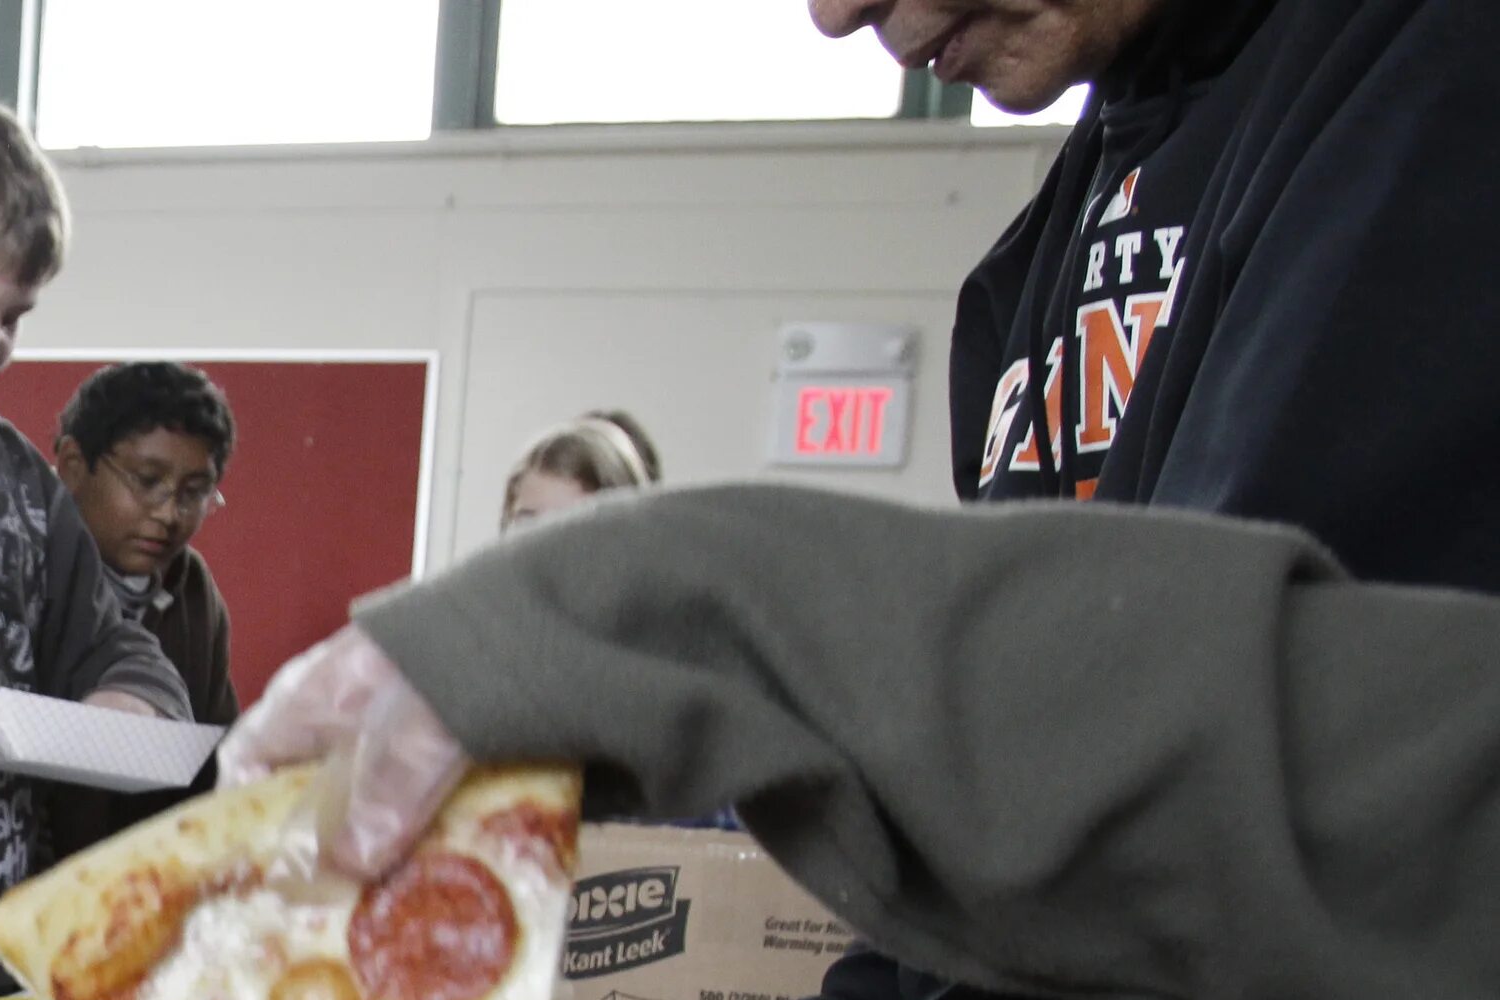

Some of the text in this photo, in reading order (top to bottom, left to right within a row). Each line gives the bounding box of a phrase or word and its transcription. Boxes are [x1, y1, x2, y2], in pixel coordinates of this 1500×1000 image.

[795, 386, 894, 456] EXIT
[765, 916, 801, 932] Great
[803, 918, 823, 933] for
[563, 929, 666, 974] Kant Leek
